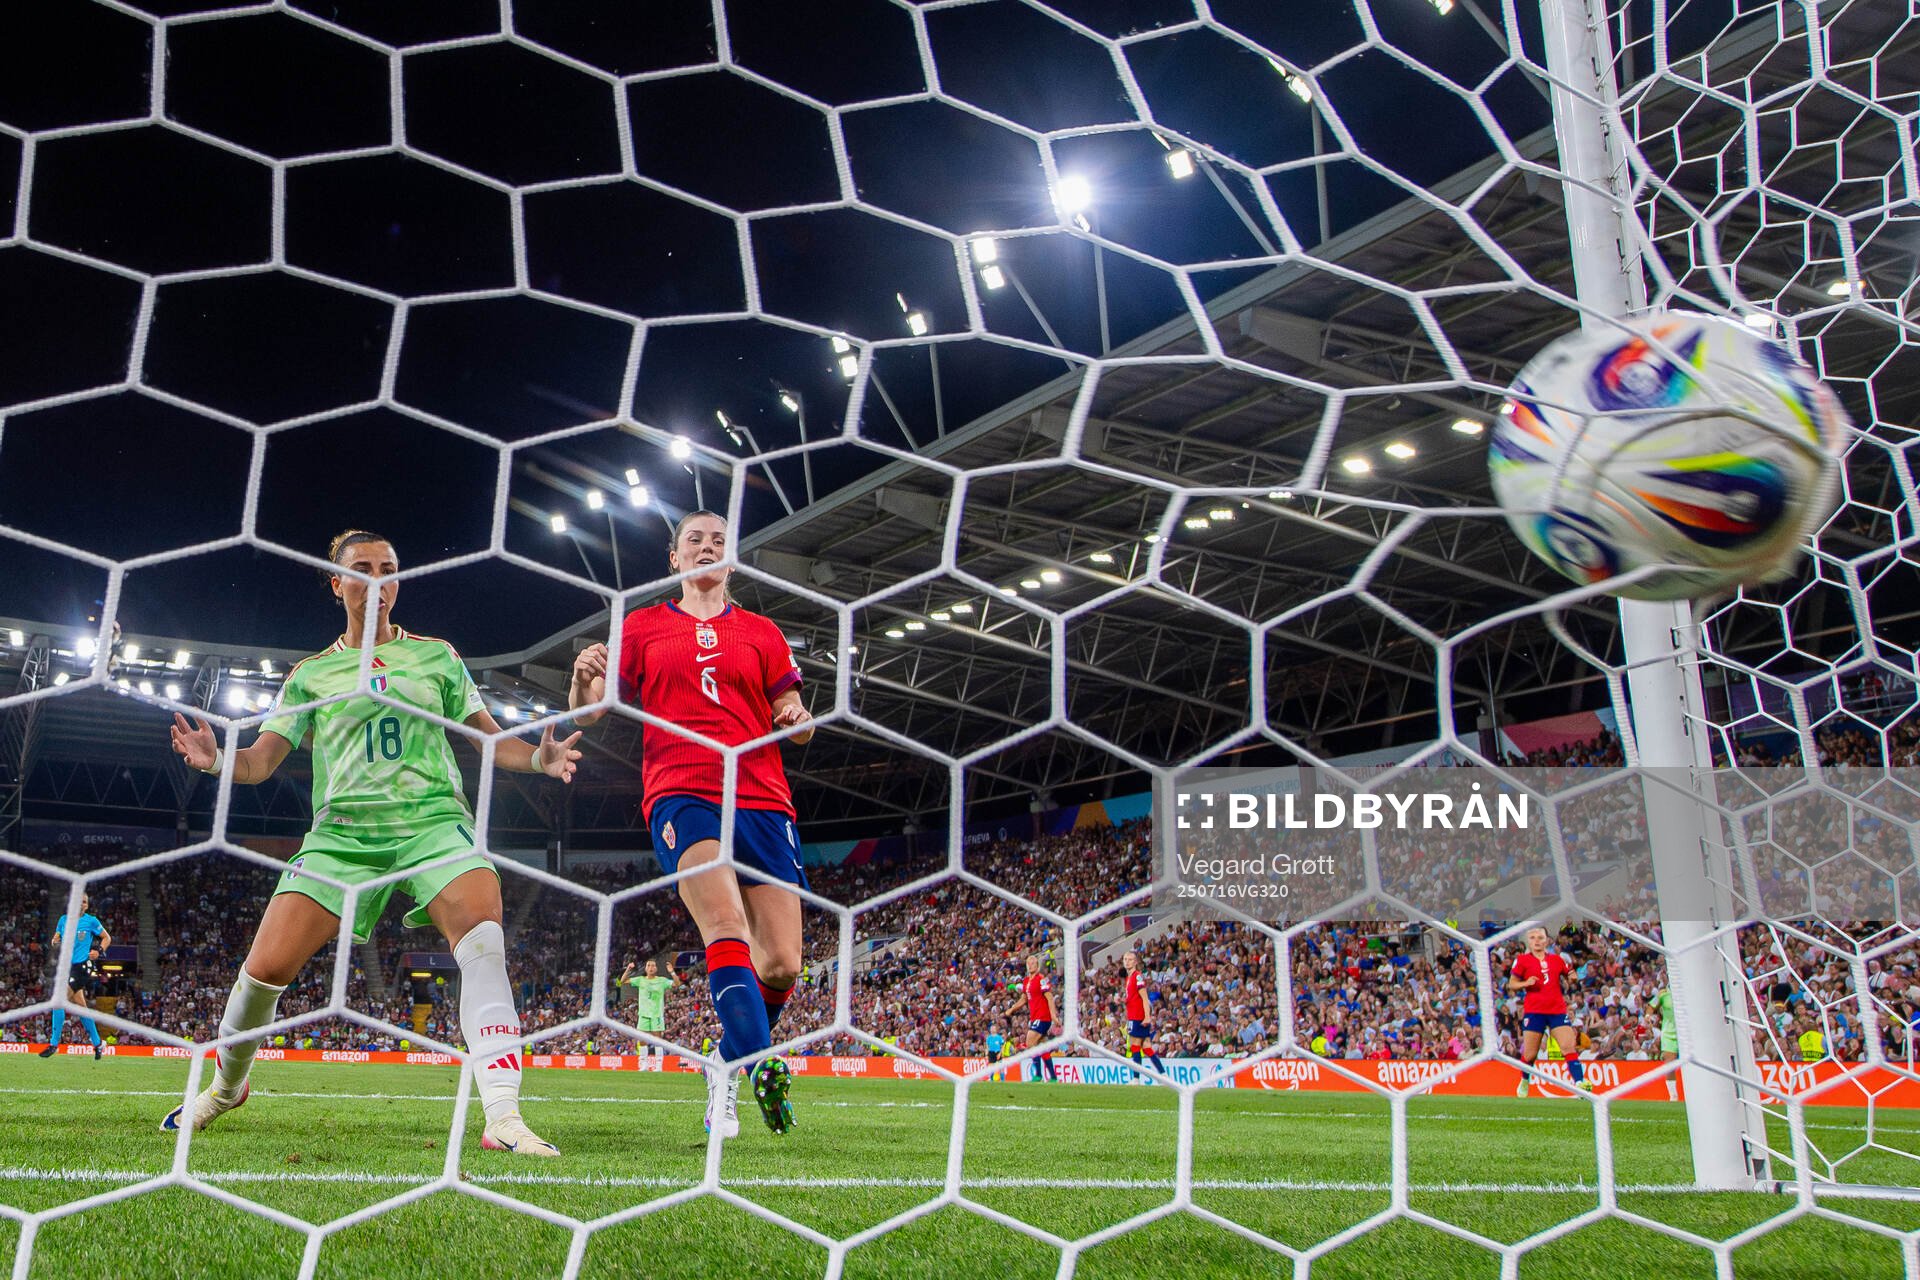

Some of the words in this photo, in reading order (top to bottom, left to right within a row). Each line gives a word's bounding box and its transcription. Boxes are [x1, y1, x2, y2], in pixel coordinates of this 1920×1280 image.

[701, 667, 720, 704] 6
[366, 717, 402, 762] 18
[0, 1042, 29, 1054] azon
[67, 1044, 116, 1056] amaon
[153, 1046, 194, 1058] amazo
[256, 1048, 285, 1059] azon
[322, 1050, 370, 1062] amazon
[406, 1051, 451, 1064] amazon
[831, 1057, 867, 1073] amazon
[1252, 1060, 1319, 1081] amazon
[1377, 1061, 1456, 1084] amazon
[1528, 1059, 1620, 1087] amaon
